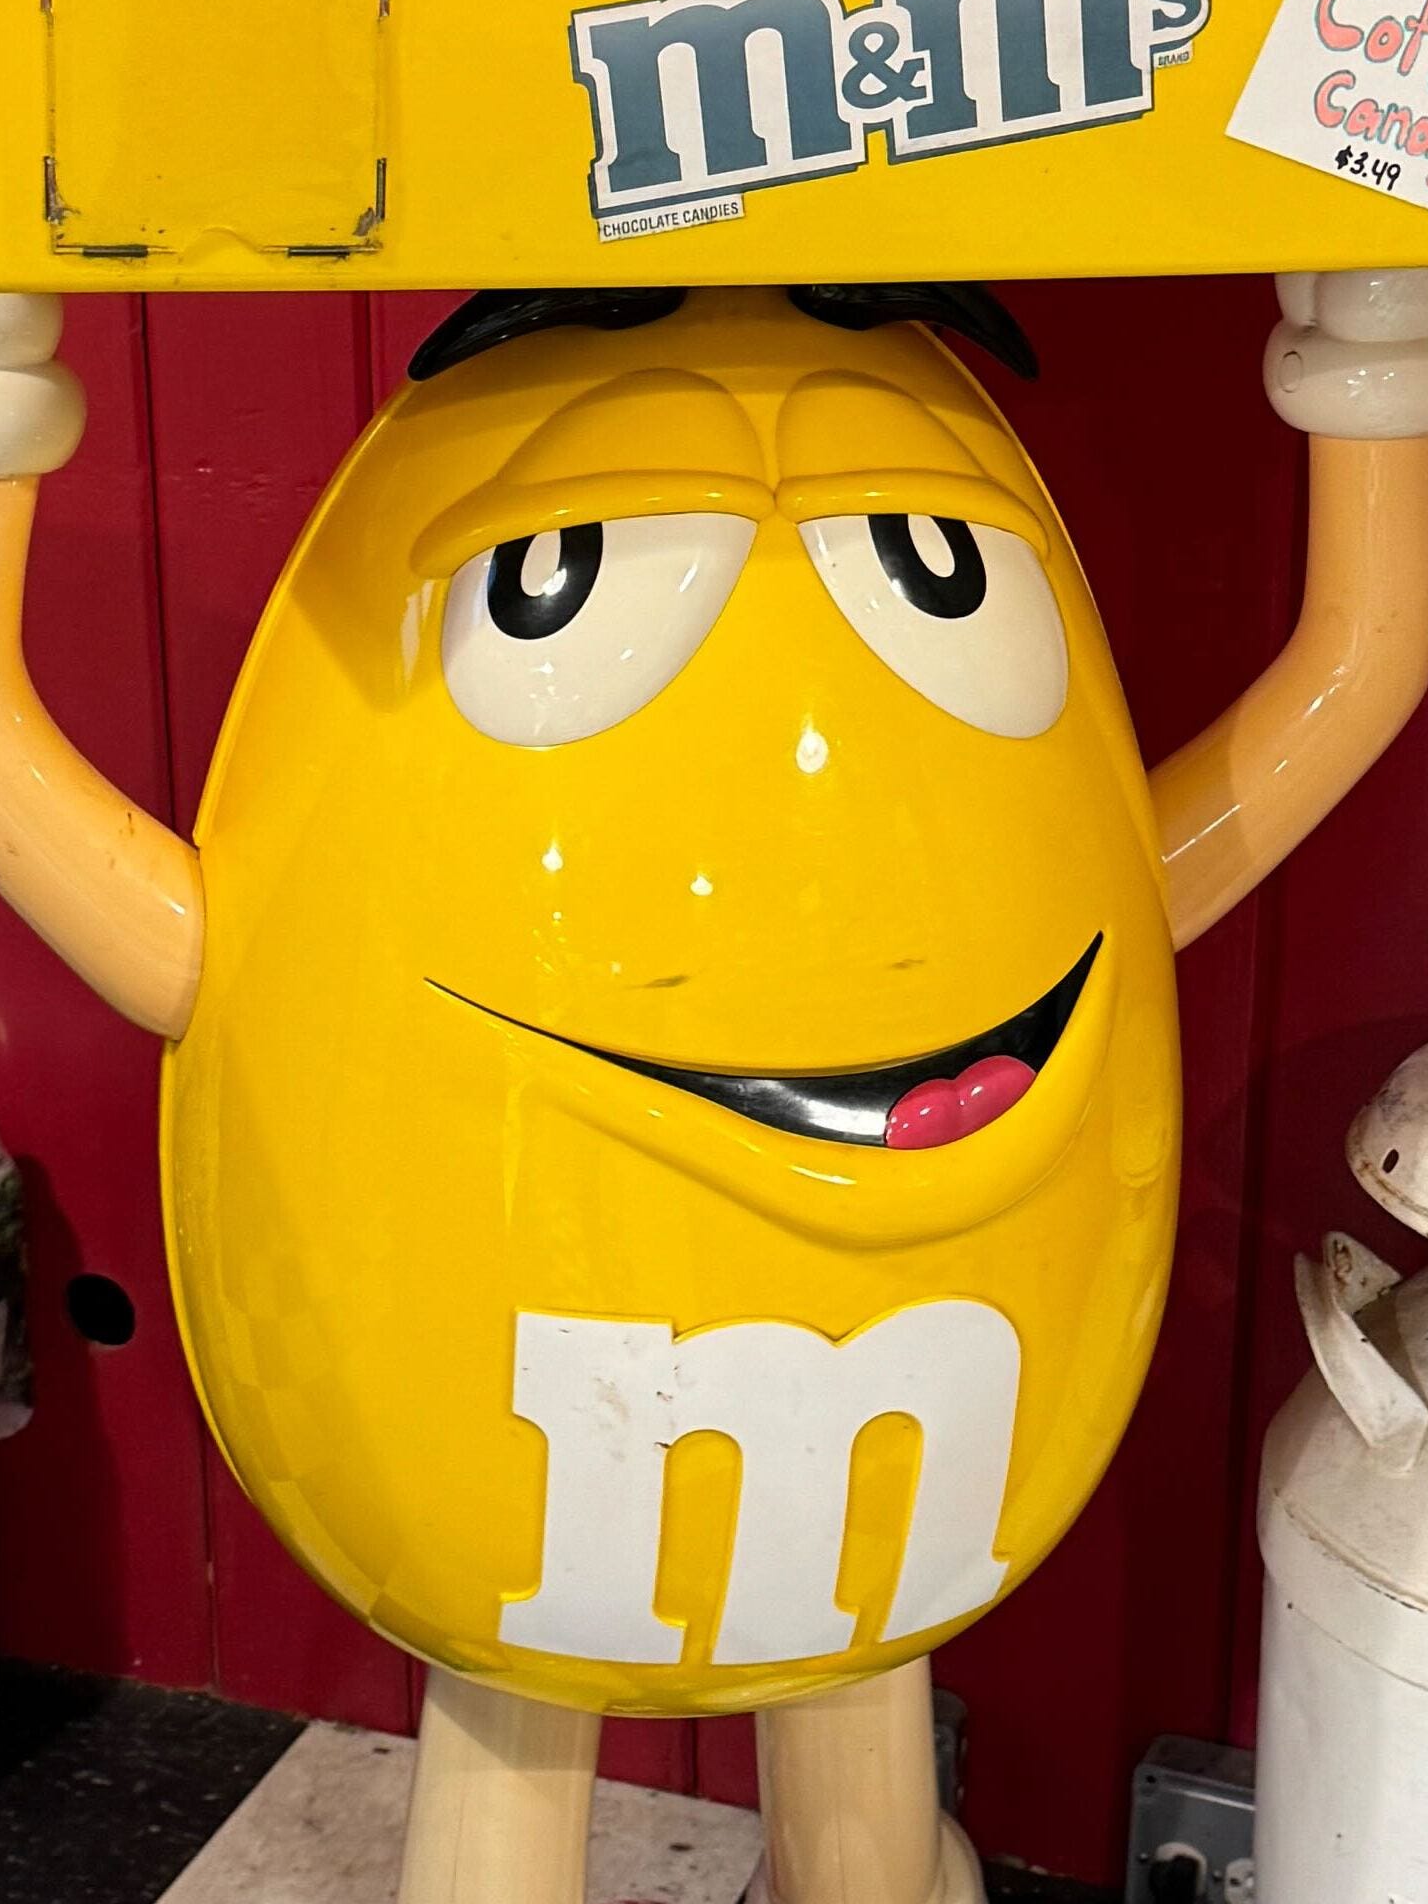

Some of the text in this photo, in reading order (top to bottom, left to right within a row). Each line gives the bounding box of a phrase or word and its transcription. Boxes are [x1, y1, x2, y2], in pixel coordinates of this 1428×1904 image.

[1158, 49, 1191, 66] BRAND
[1334, 145, 1402, 191] $3.49
[602, 200, 740, 240] CHOCOLATE CANDIES
[496, 1298, 1022, 1665] m
